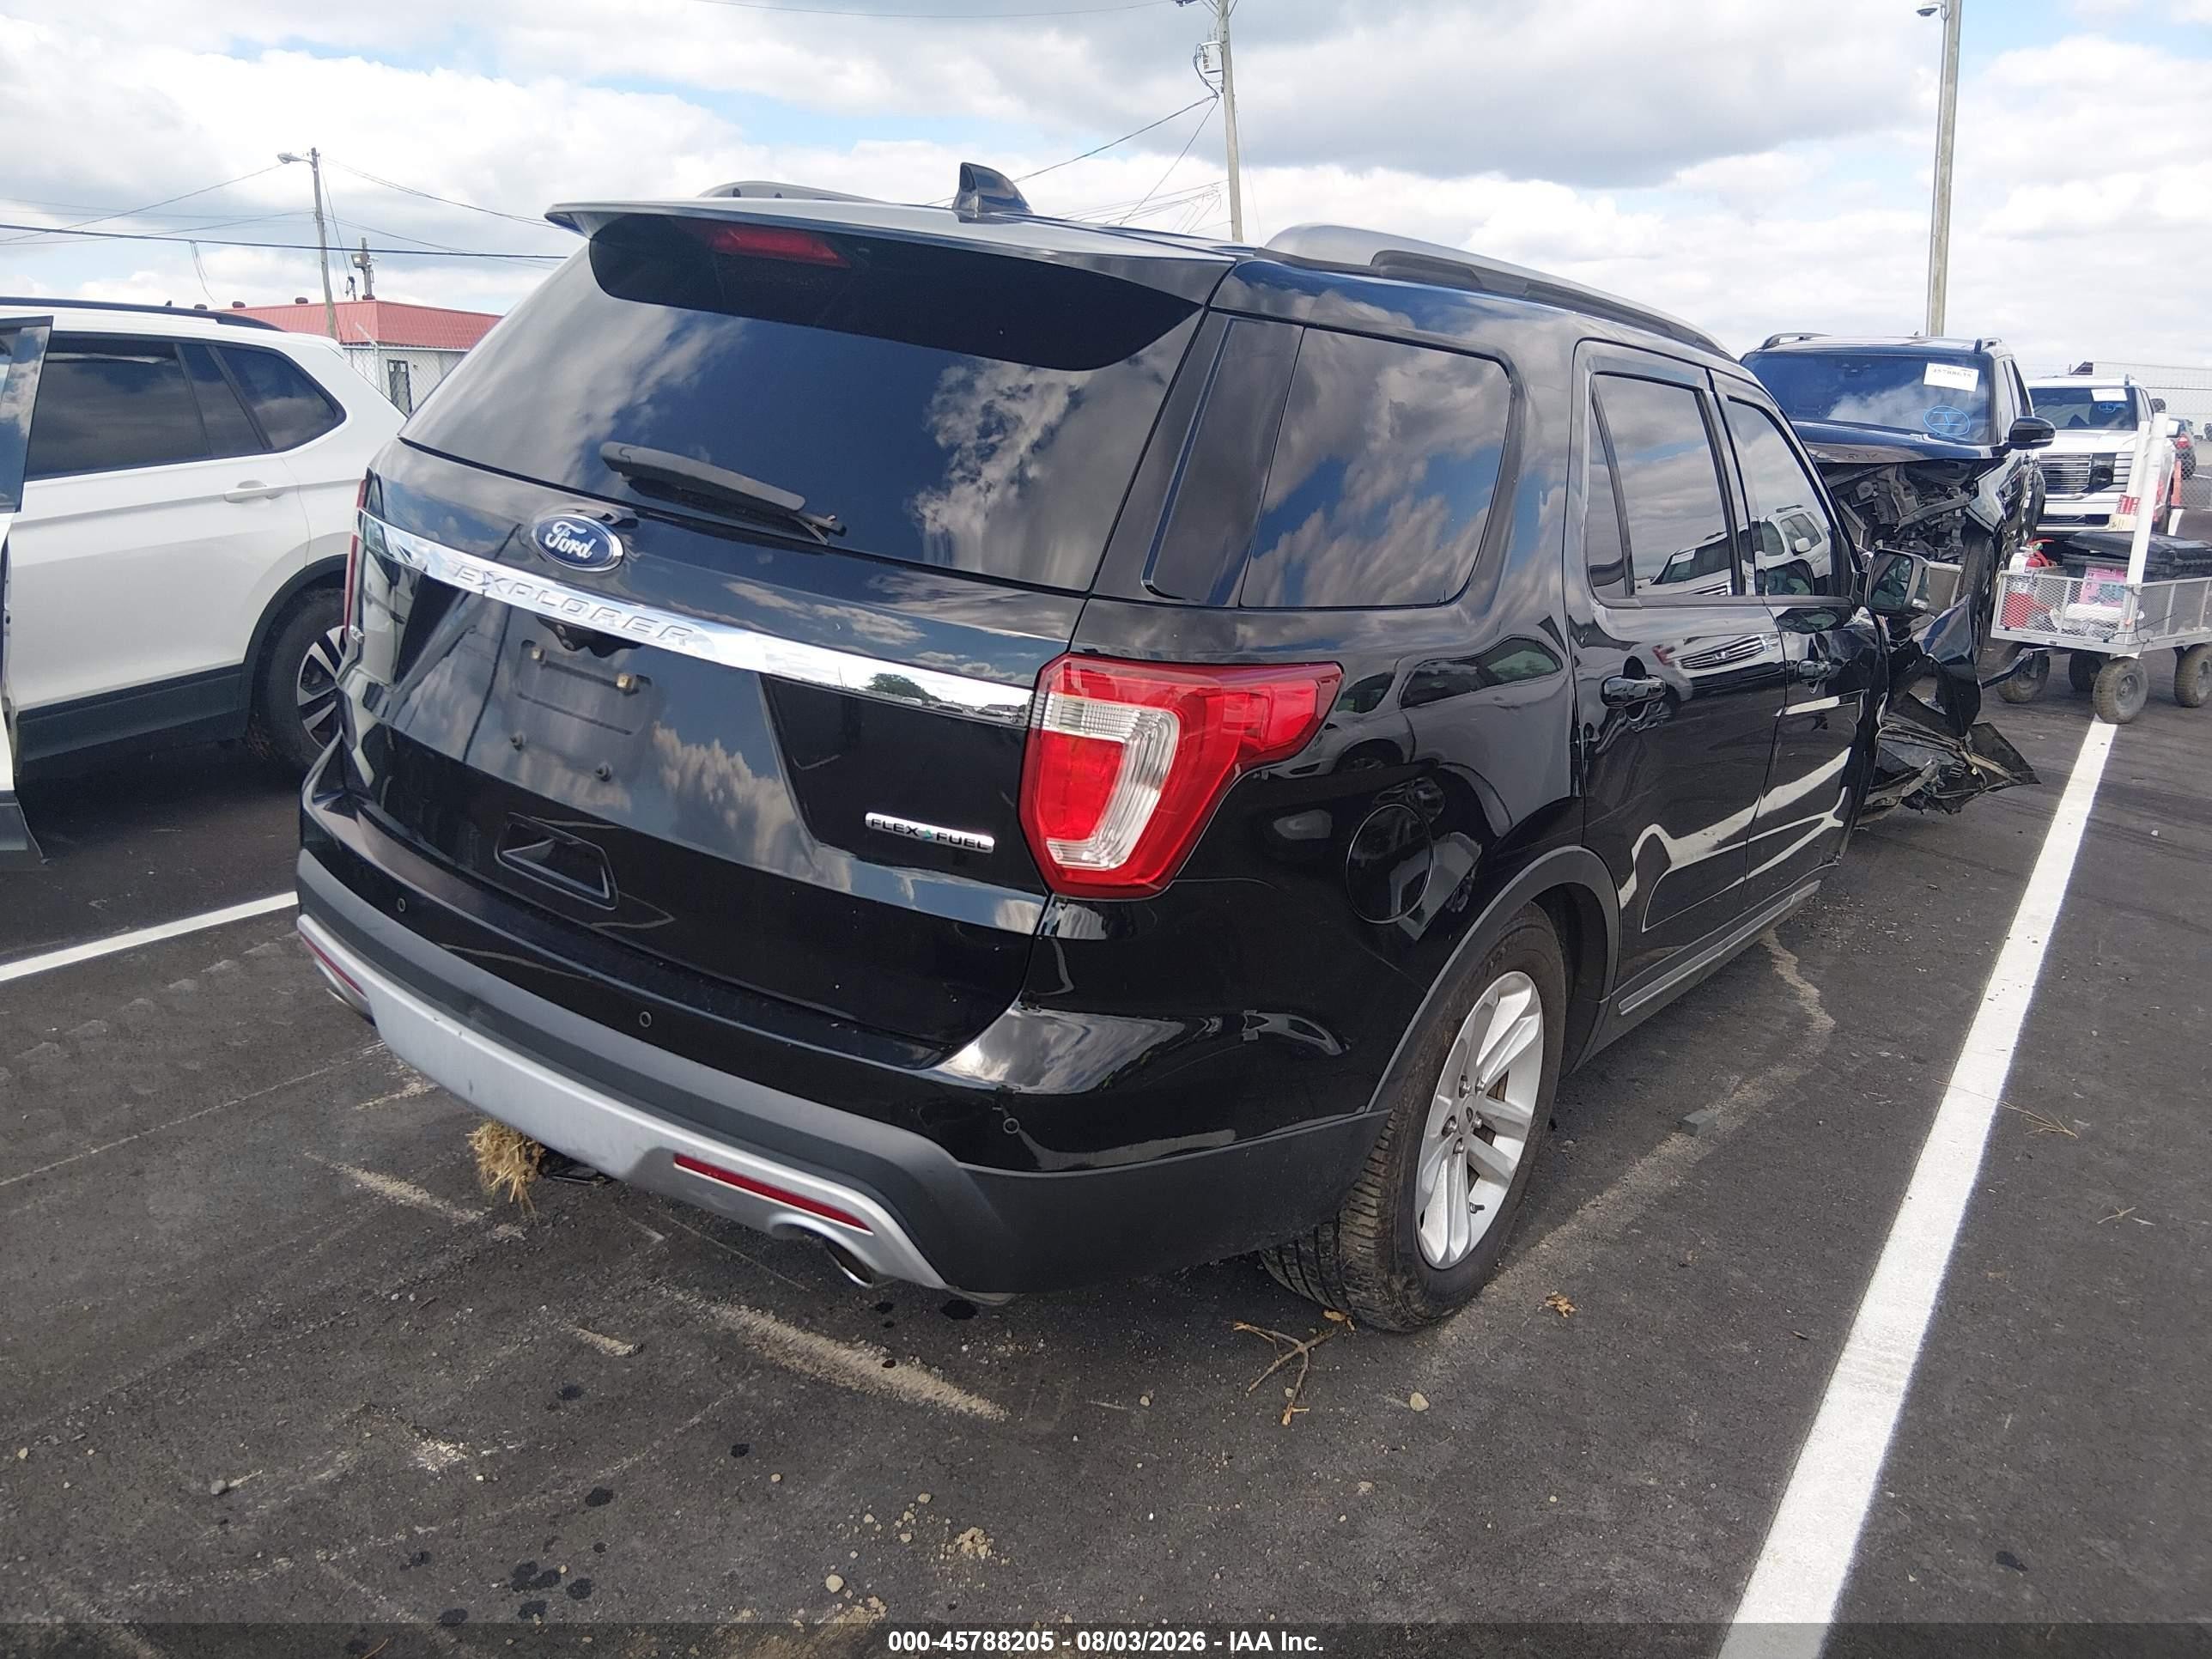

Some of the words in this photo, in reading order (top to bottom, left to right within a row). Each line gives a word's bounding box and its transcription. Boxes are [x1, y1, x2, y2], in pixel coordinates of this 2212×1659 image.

[544, 520, 598, 559] Ford
[454, 563, 694, 647] EXPLORER
[871, 818, 919, 837] FLEX
[936, 831, 993, 851] FUEL
